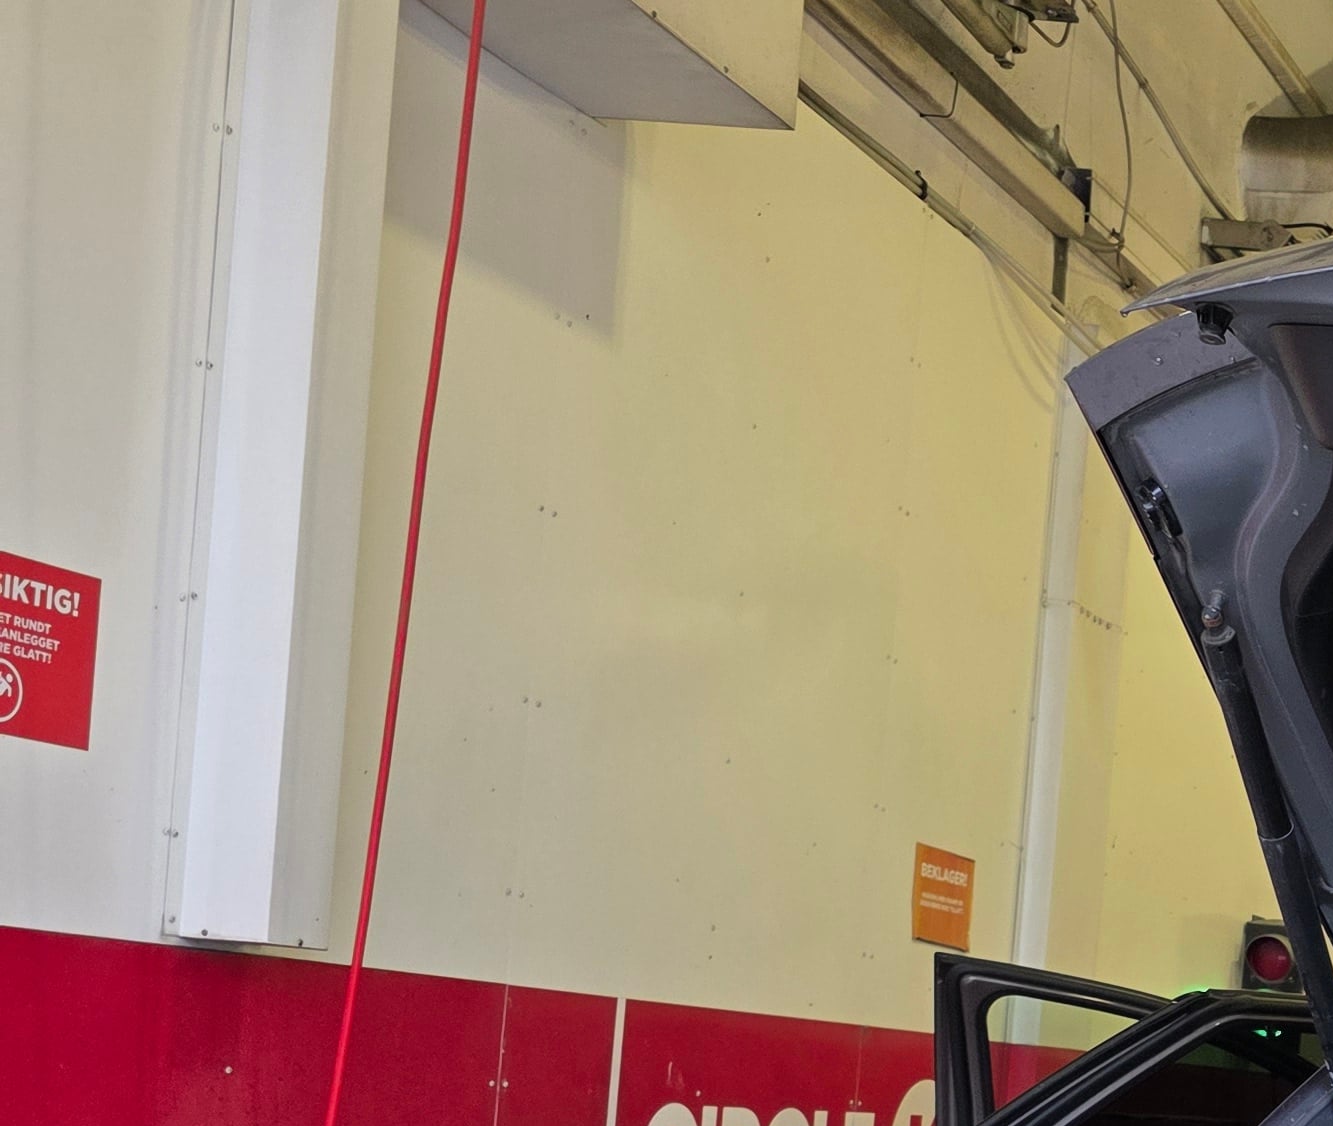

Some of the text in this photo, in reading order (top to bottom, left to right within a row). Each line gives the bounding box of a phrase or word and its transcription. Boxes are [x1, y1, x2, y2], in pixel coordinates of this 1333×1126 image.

[0, 573, 80, 617] IKTIG!
[14, 615, 52, 635] RUNDT
[13, 645, 52, 664] GLATT!
